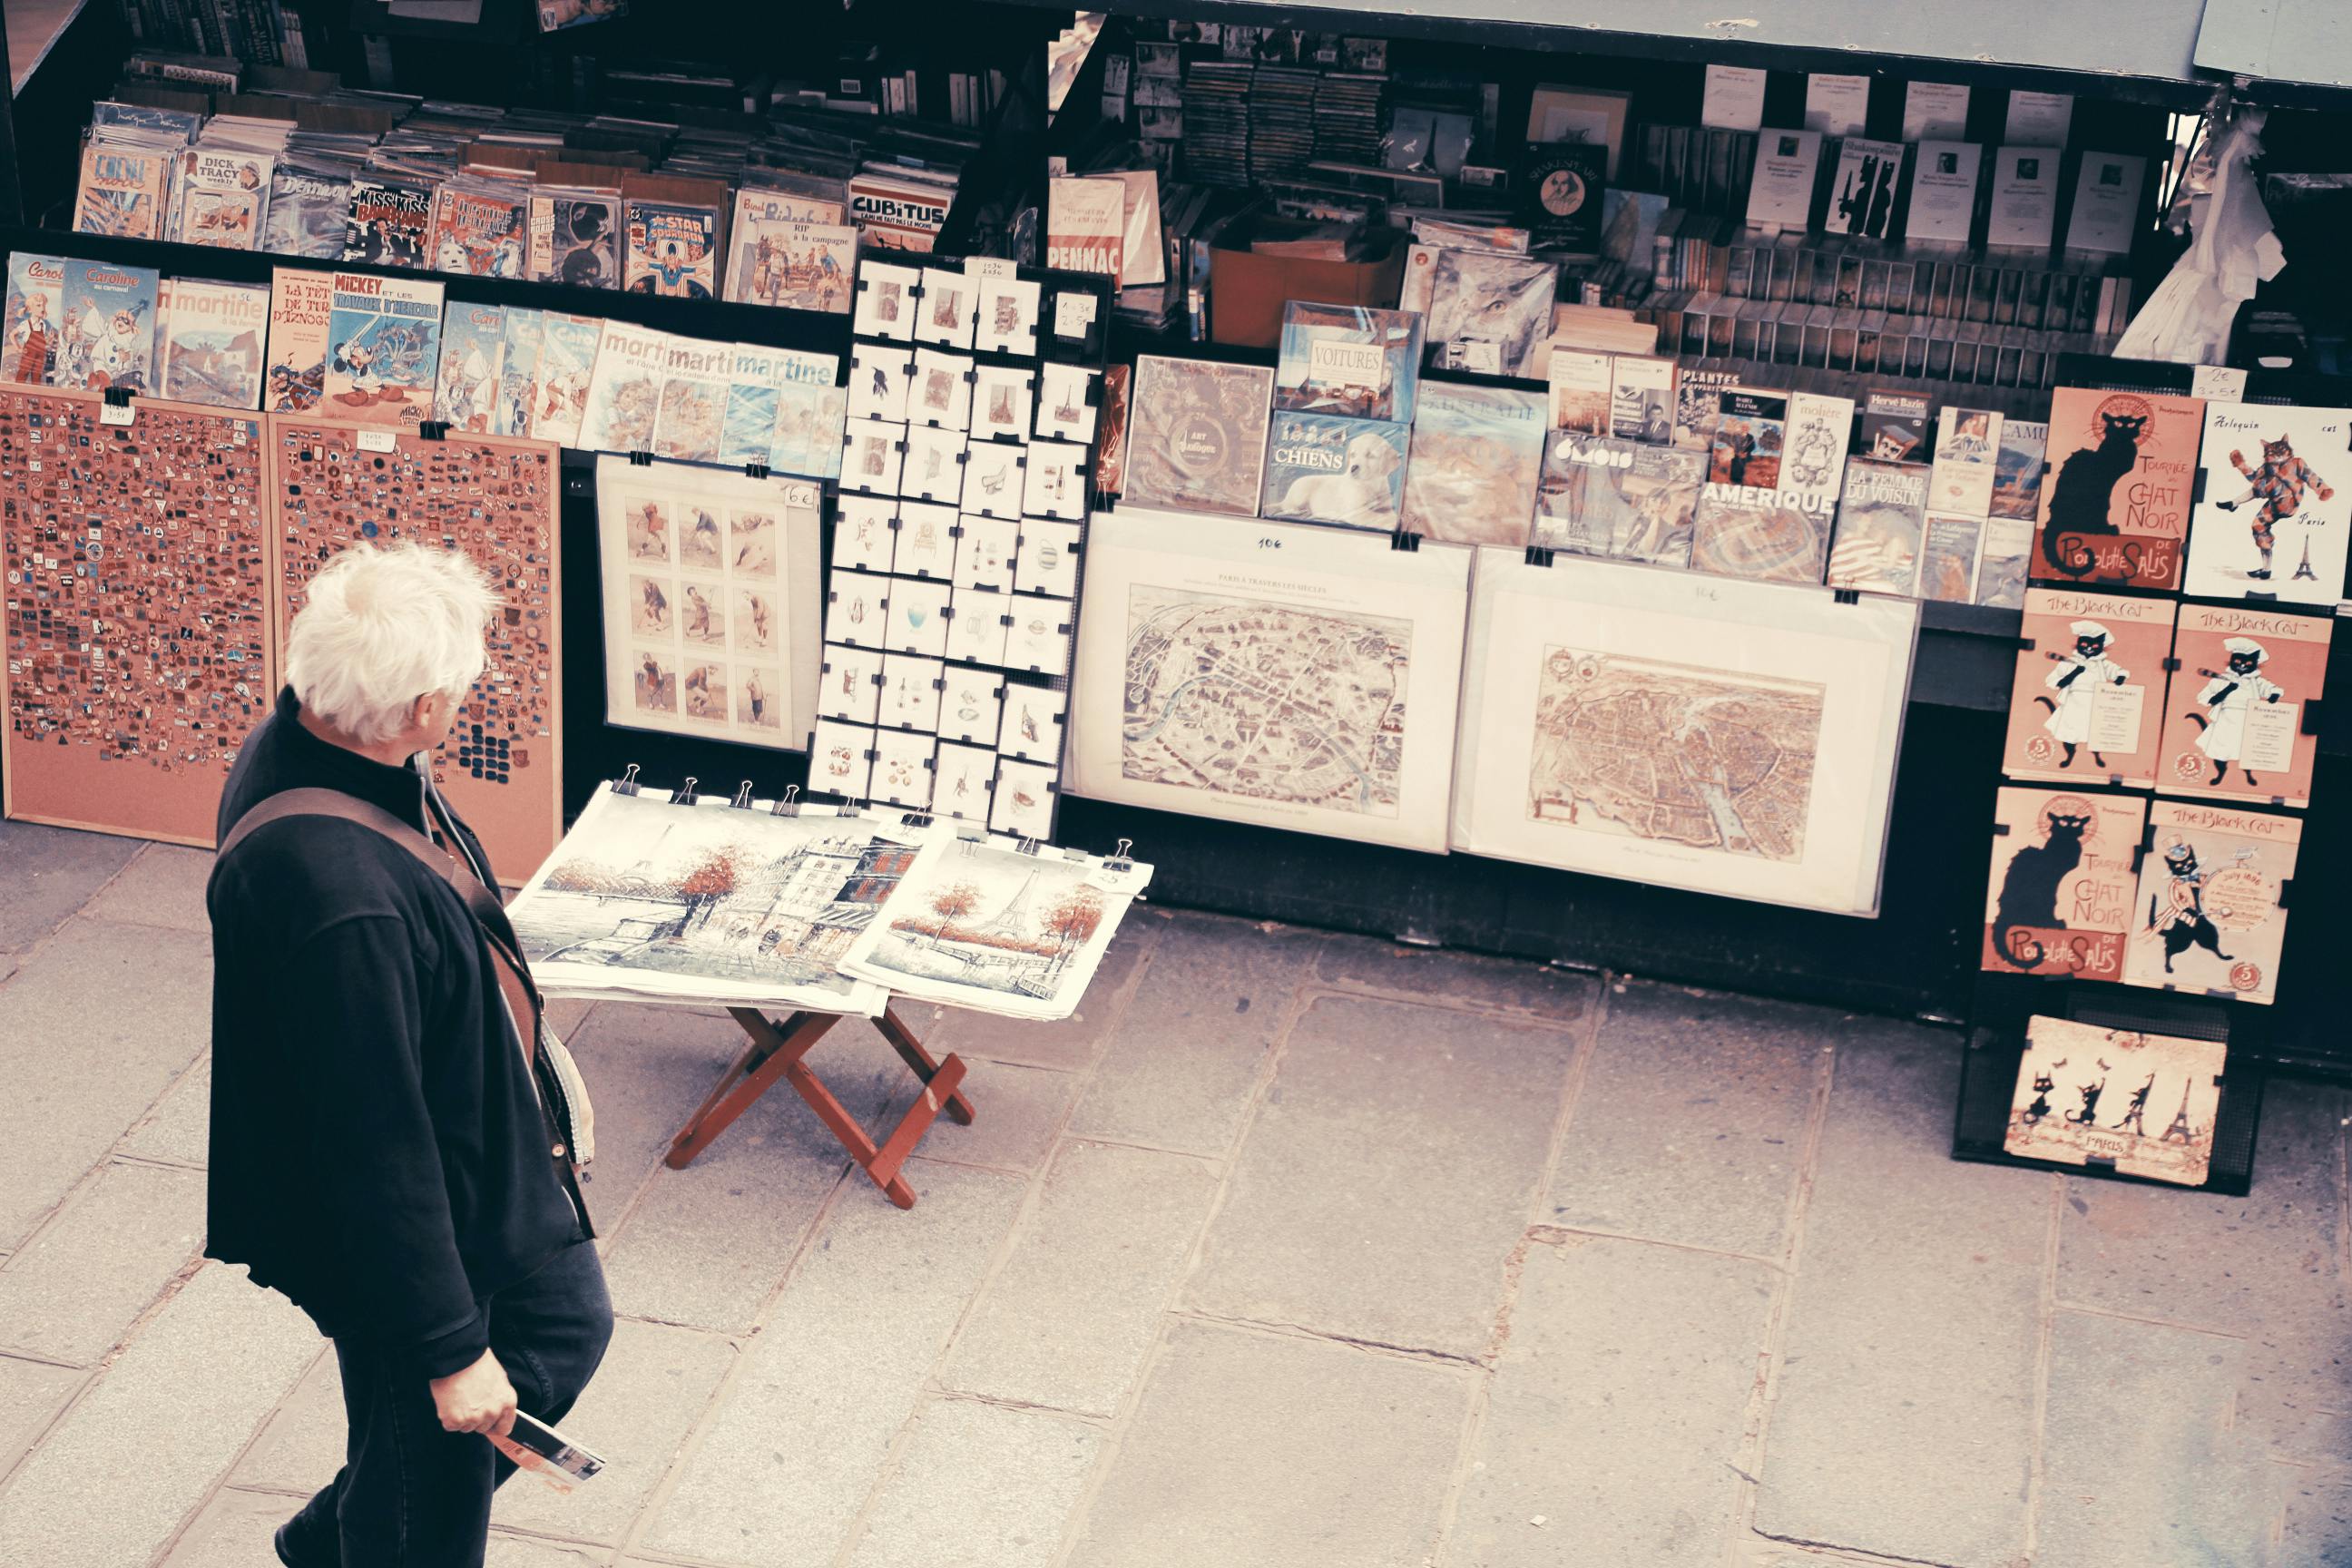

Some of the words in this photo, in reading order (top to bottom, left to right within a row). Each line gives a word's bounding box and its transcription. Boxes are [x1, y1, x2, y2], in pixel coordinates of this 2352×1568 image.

[205, 157, 234, 170] DICK
[200, 167, 240, 179] TRACY
[360, 190, 394, 207] KISS
[397, 195, 429, 213] KISS
[667, 217, 702, 235] STAR
[812, 236, 848, 246] campagne
[1048, 246, 1119, 275] PENNAC
[86, 269, 140, 287] Caroline
[103, 285, 129, 293] carnaval
[285, 284, 302, 296] LA
[176, 292, 263, 318] martine
[285, 299, 301, 309] DE
[307, 299, 330, 313] TUR
[334, 293, 381, 312] TRAVAUX
[605, 333, 664, 355] mart
[1315, 347, 1380, 370] VOITURES
[736, 352, 831, 385] martine
[1682, 370, 1740, 386] PLANTES
[1800, 404, 1841, 418] molière
[1872, 395, 1899, 407] Hervé
[1901, 398, 1925, 410] Bazin
[1191, 432, 1207, 441] ART
[2321, 425, 2337, 433] cat
[1274, 448, 1343, 470] CHIENS
[1847, 468, 1867, 484] LA
[1871, 470, 1924, 490] FEMME
[1700, 482, 1836, 515] AMERIQUE
[1846, 484, 1867, 499] DU
[1871, 485, 1920, 506] VOISIN
[2128, 483, 2179, 512] CHAT
[2126, 505, 2180, 534] NOIR
[2298, 512, 2327, 526] Paris
[2156, 540, 2171, 550] DE
[1219, 573, 1239, 583] PARIS
[1249, 578, 1281, 589] TRAVERS
[2047, 595, 2072, 612] The
[2074, 596, 2117, 616] Black
[2117, 601, 2153, 617] Cat
[2200, 611, 2225, 629] The
[2228, 613, 2271, 632] Black
[2271, 619, 2309, 634] Cat
[2035, 739, 2045, 752] 5
[2186, 757, 2196, 770] 5
[2173, 808, 2199, 825] The
[2202, 810, 2248, 830] Black
[2248, 818, 2286, 835] Cat
[2074, 878, 2123, 906] CHAT
[2073, 901, 2125, 929] NOIR
[2102, 935, 2117, 945] DE
[2241, 967, 2252, 980] 5
[2086, 1135, 2124, 1153] PARIS
